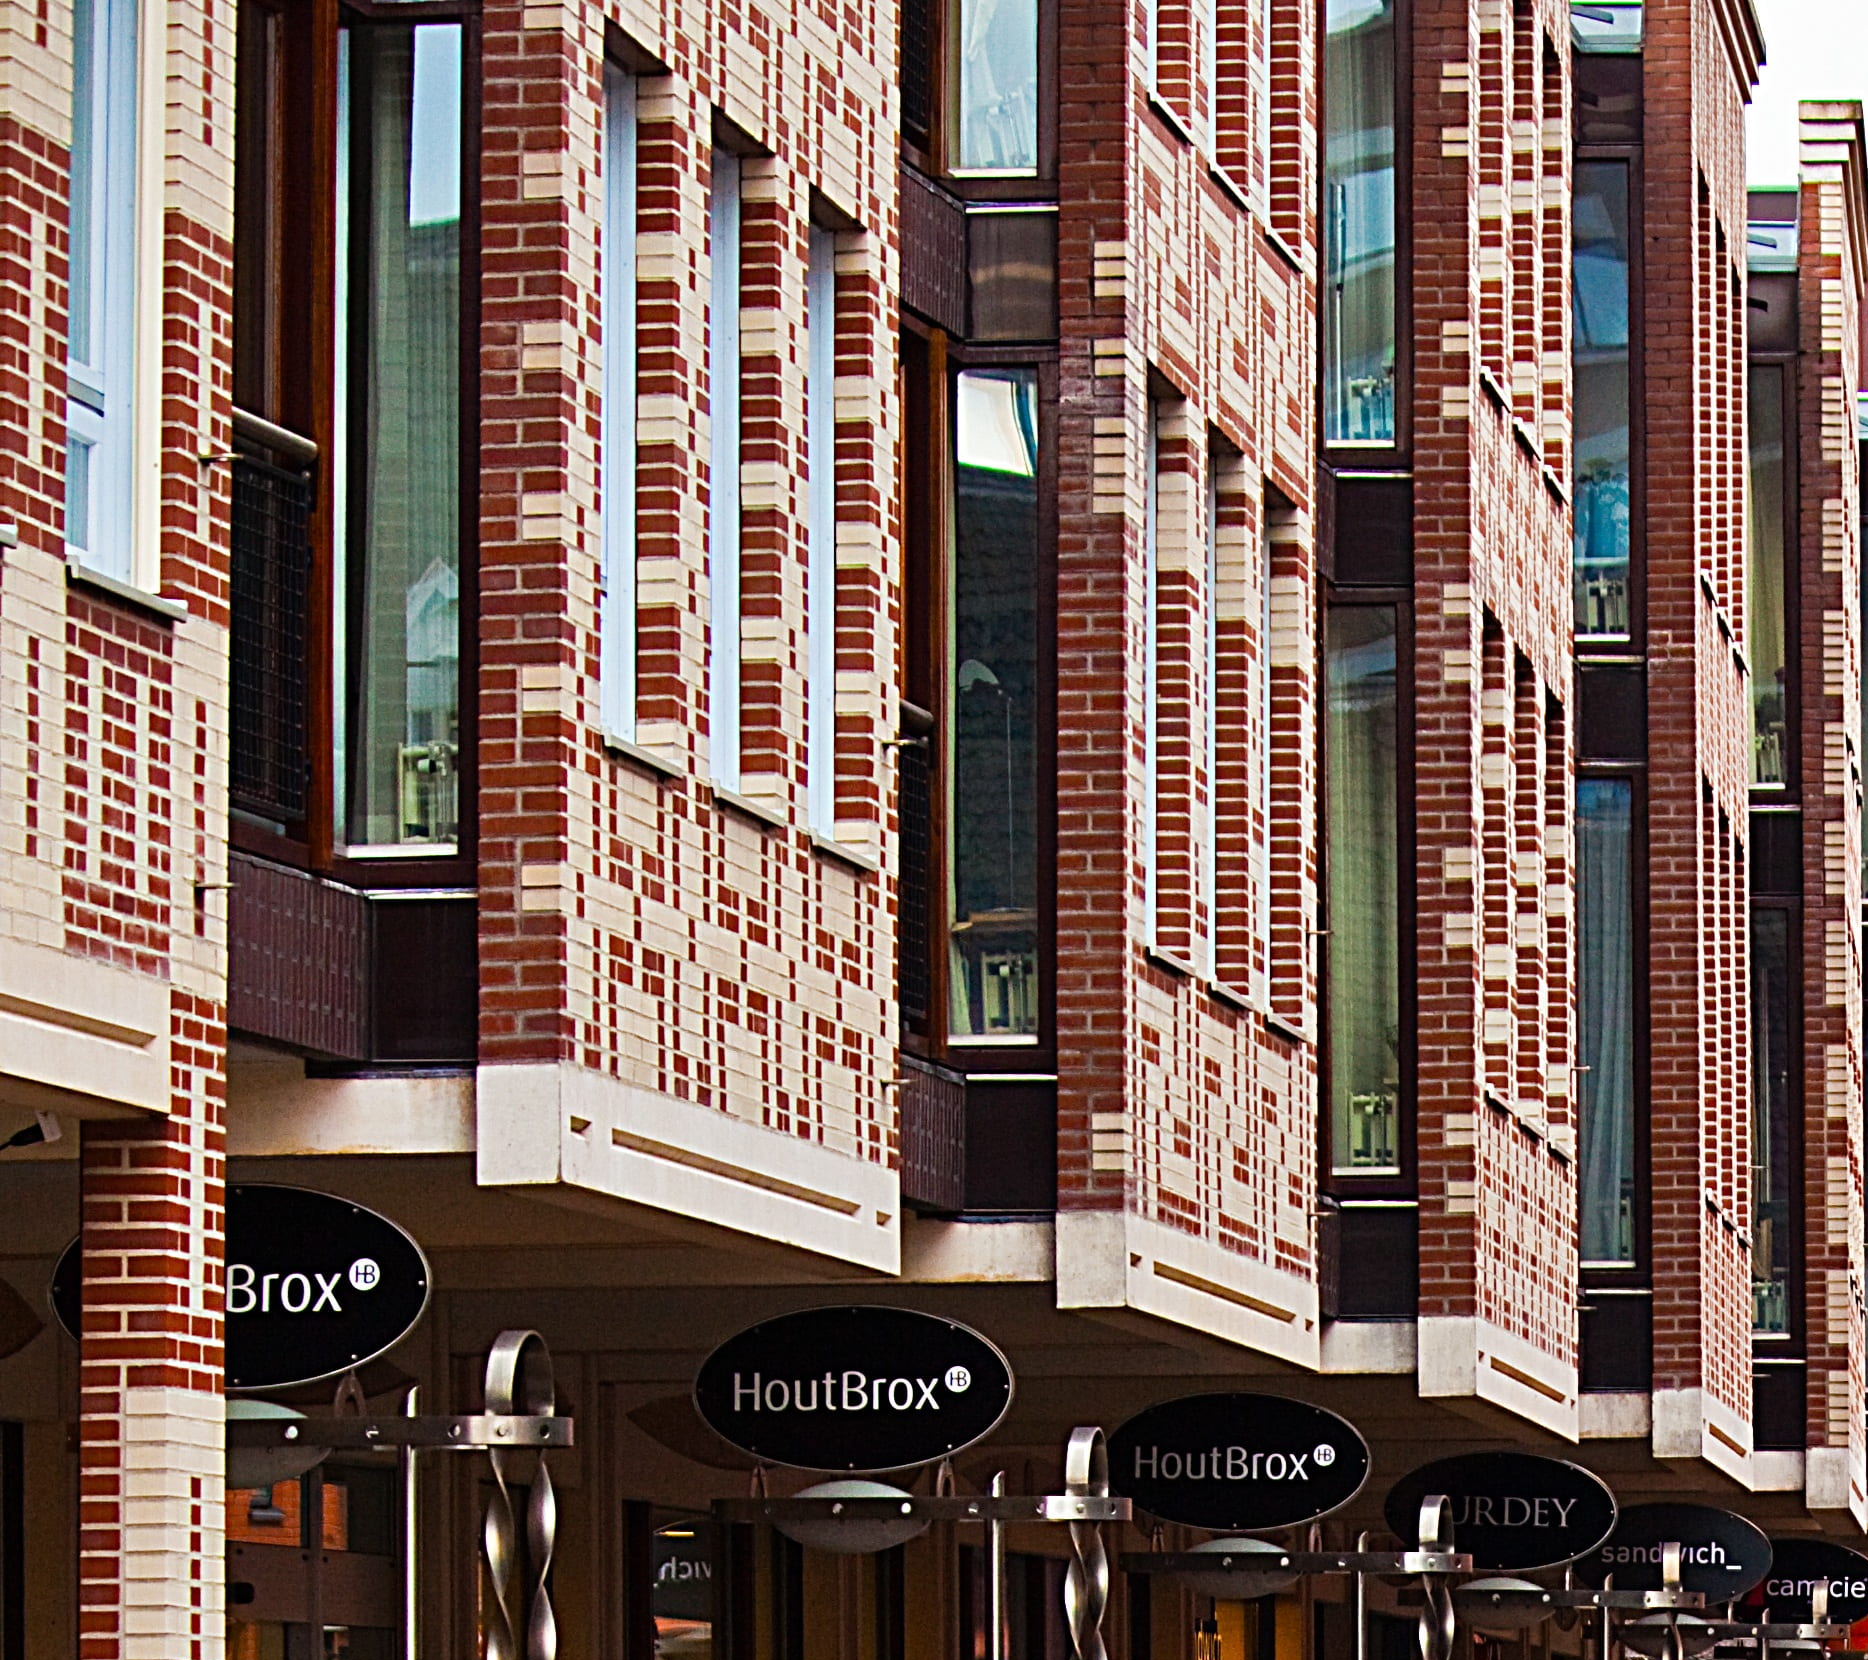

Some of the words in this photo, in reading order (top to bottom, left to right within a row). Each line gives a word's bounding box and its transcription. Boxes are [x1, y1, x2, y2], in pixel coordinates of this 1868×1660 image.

[225, 1263, 343, 1313] Brox
[734, 1371, 940, 1412] HoutBrox
[1134, 1446, 1309, 1480] HoutBrox
[1453, 1495, 1579, 1528] URDEY
[1601, 1541, 1742, 1571] sandich_
